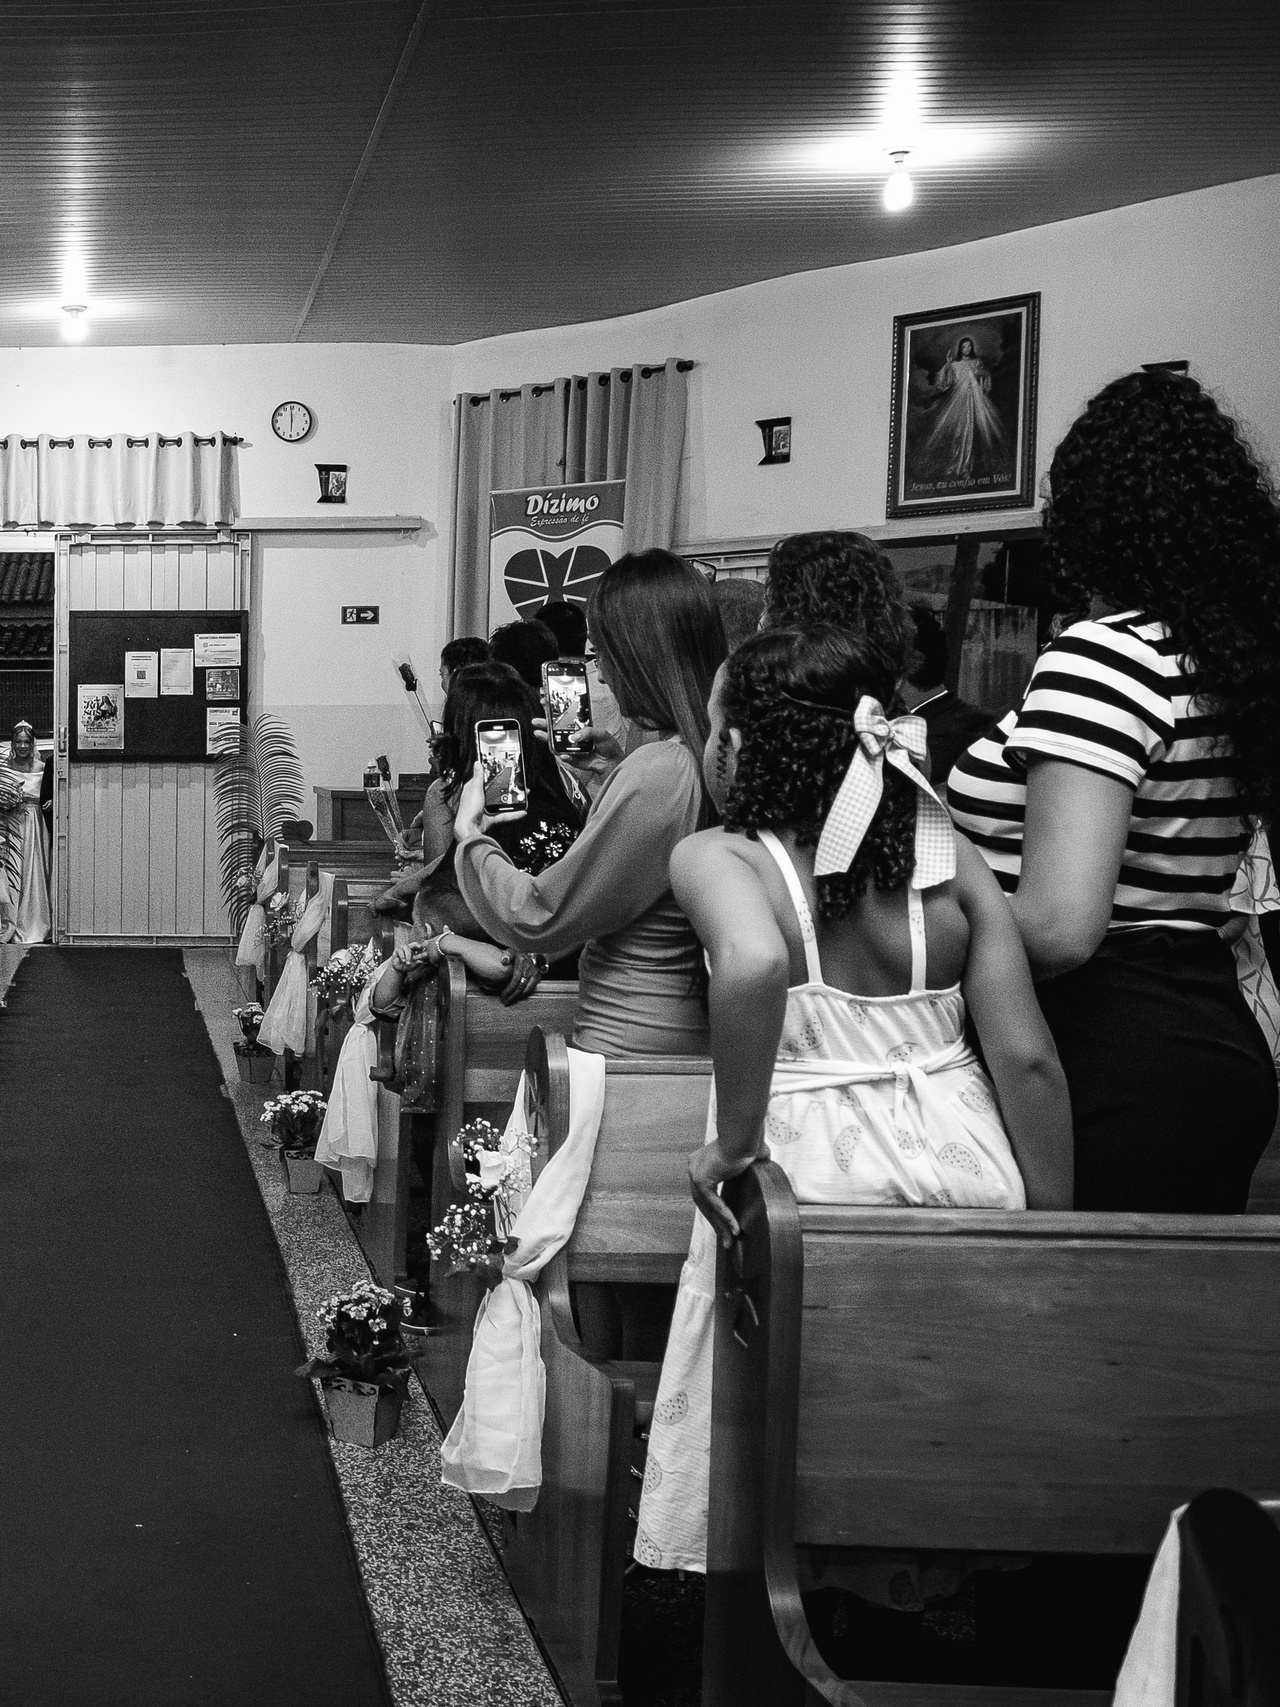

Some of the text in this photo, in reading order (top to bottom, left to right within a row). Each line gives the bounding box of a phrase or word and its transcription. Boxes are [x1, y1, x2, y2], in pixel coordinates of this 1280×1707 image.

[526, 492, 599, 515] Dízimo
[530, 512, 591, 528] Expressão de fé
